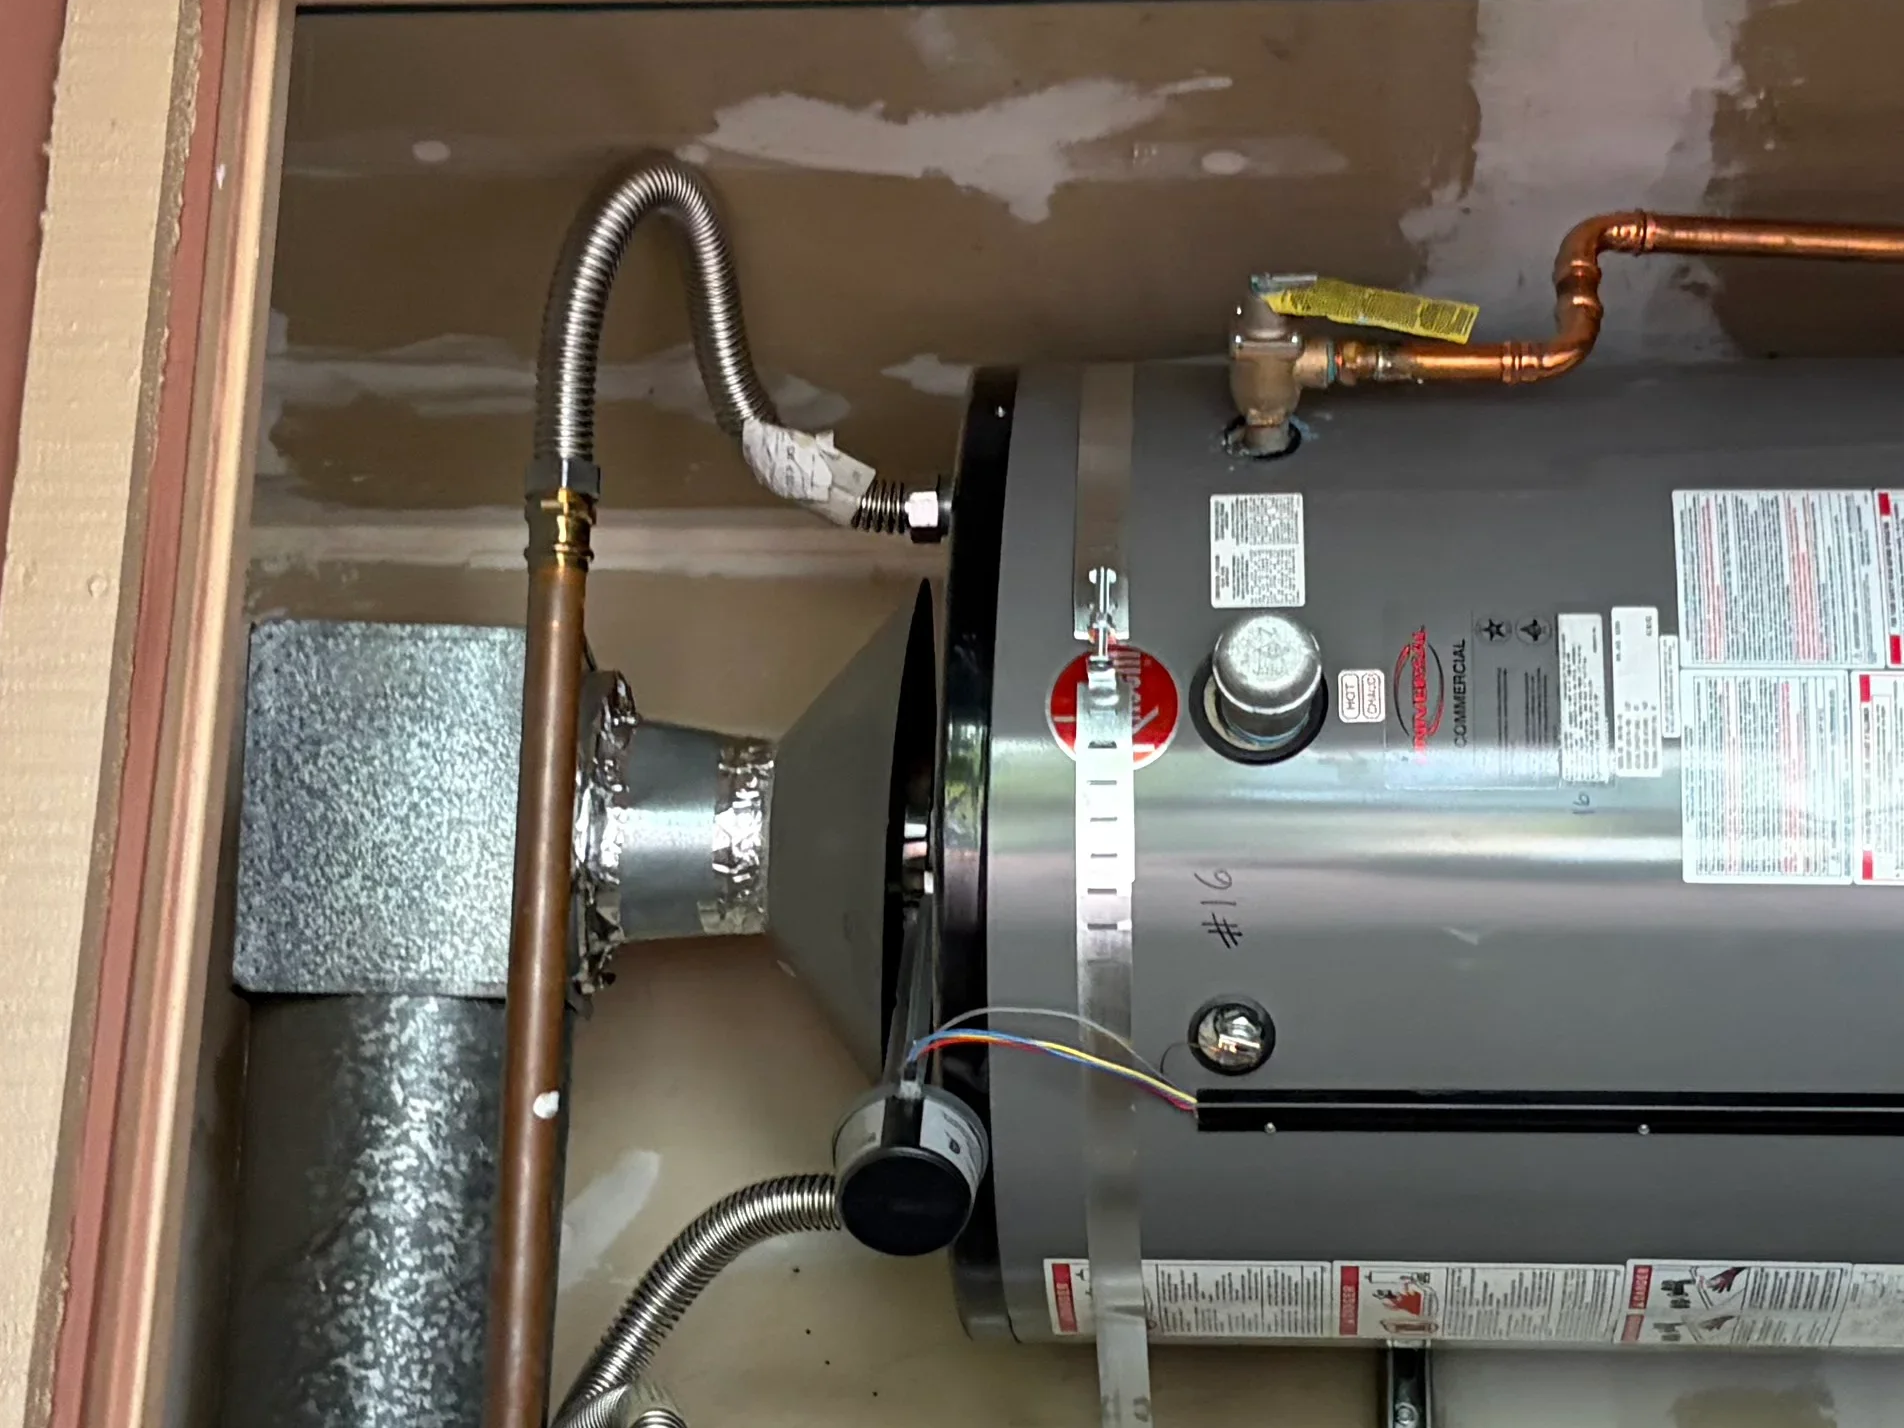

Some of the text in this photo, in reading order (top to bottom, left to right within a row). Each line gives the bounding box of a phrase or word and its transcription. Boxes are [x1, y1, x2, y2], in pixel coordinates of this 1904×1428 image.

[1345, 681, 1356, 710] HOT
[1453, 639, 1468, 748] COMMERCIAL
[1194, 870, 1243, 949] #16
